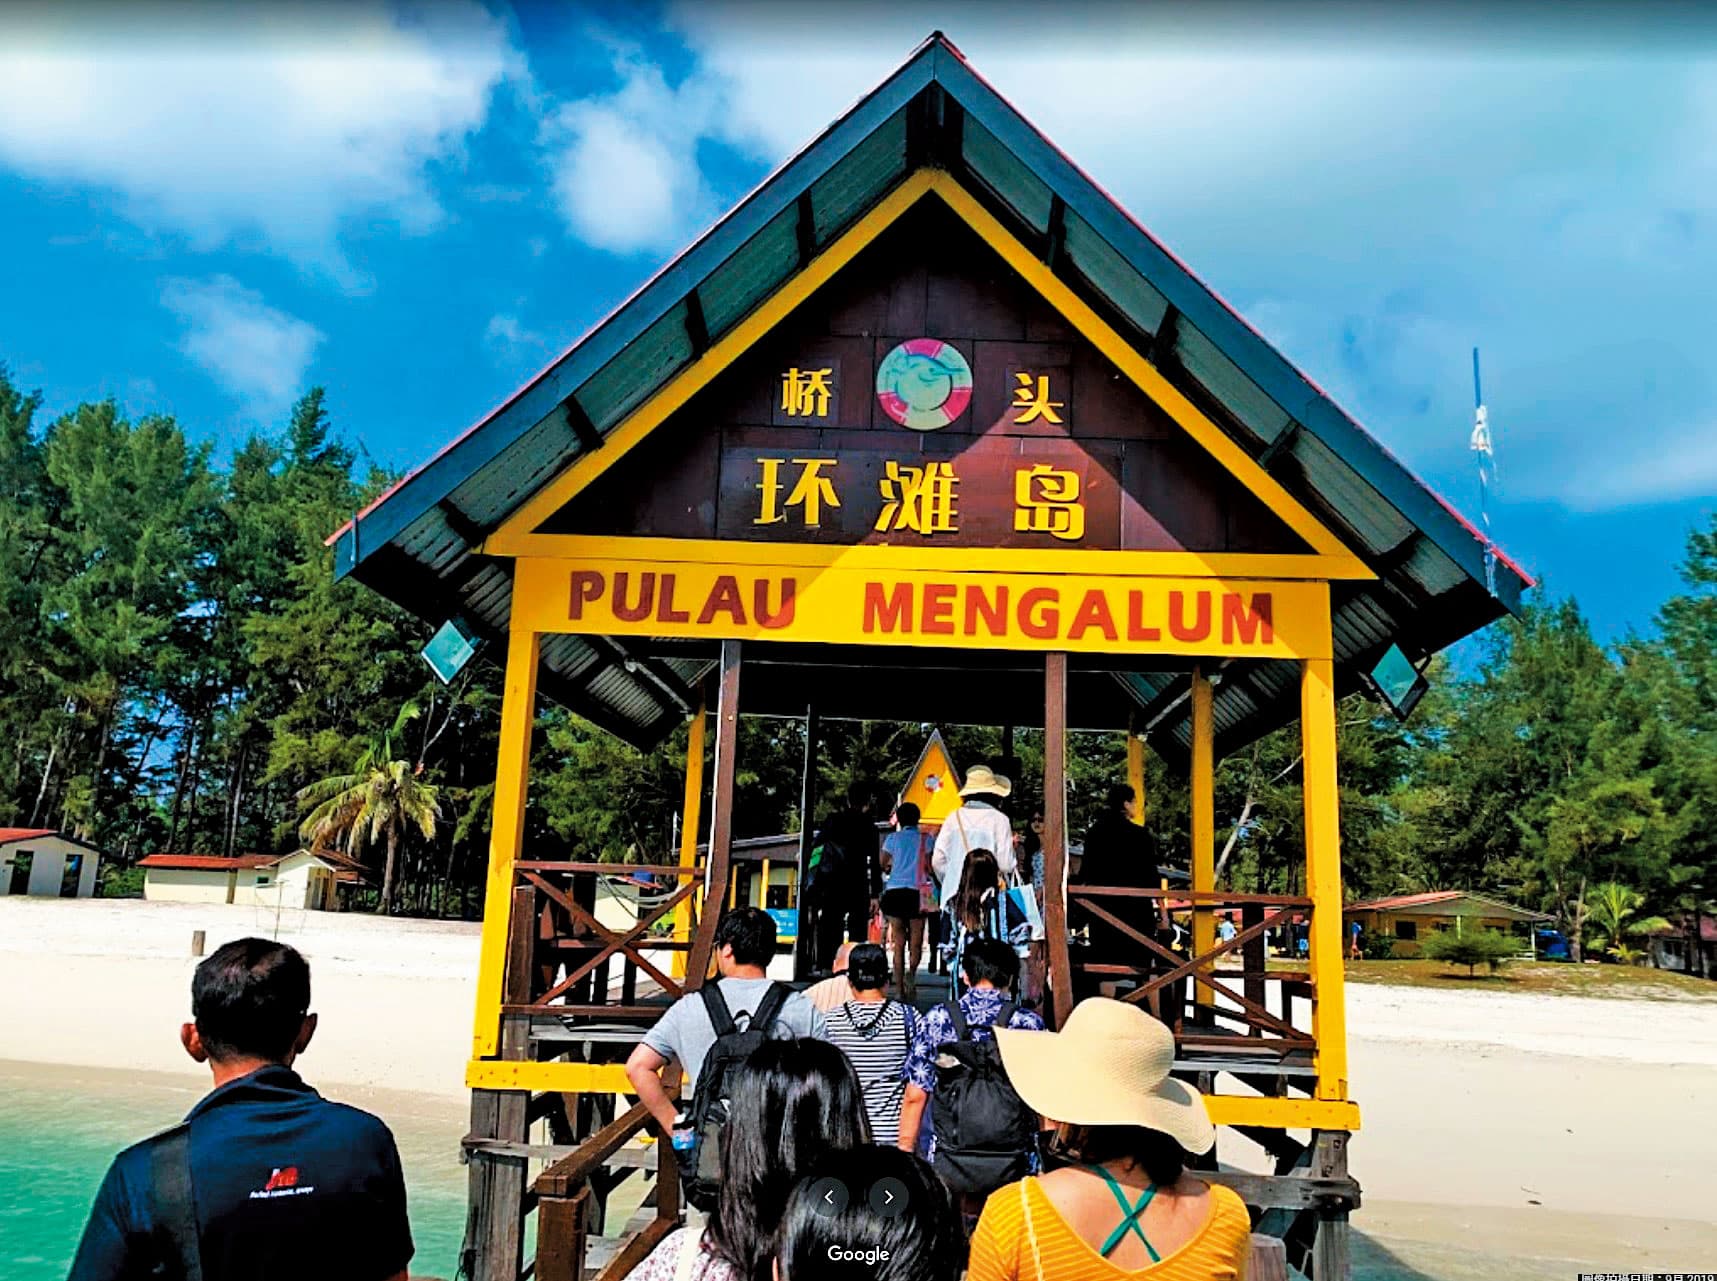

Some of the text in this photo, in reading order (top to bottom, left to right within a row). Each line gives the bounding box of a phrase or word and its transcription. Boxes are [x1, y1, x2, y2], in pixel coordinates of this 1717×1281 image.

[781, 367, 1064, 424] 桥 头
[753, 458, 1086, 540] 环滩岛
[568, 570, 1274, 645] PULAU MENGALUM
